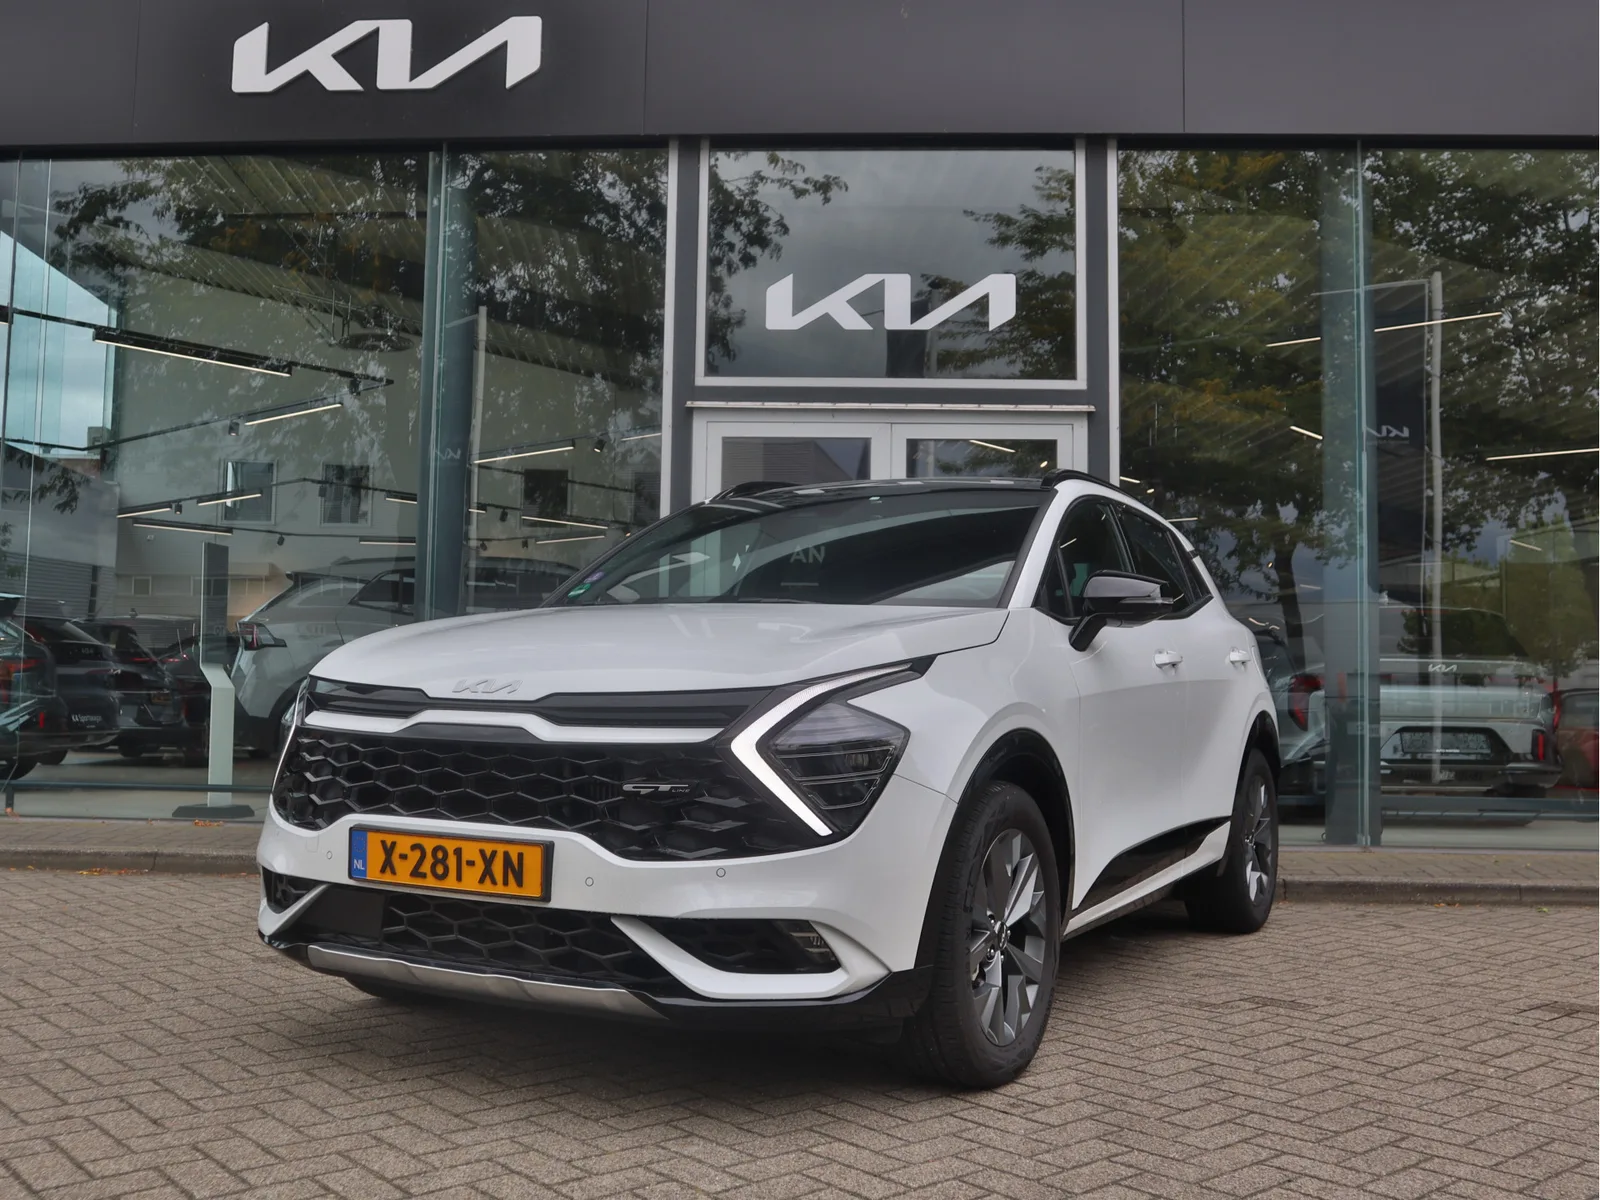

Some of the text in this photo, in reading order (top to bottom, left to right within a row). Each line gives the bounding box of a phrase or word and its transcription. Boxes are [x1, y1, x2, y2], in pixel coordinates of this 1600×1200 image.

[231, 15, 542, 93] KIA
[765, 273, 1017, 331] KIA
[1428, 664, 1457, 672] KIA
[452, 679, 523, 694] KIA
[353, 858, 365, 871] NL
[379, 839, 525, 888] X-281-XN
